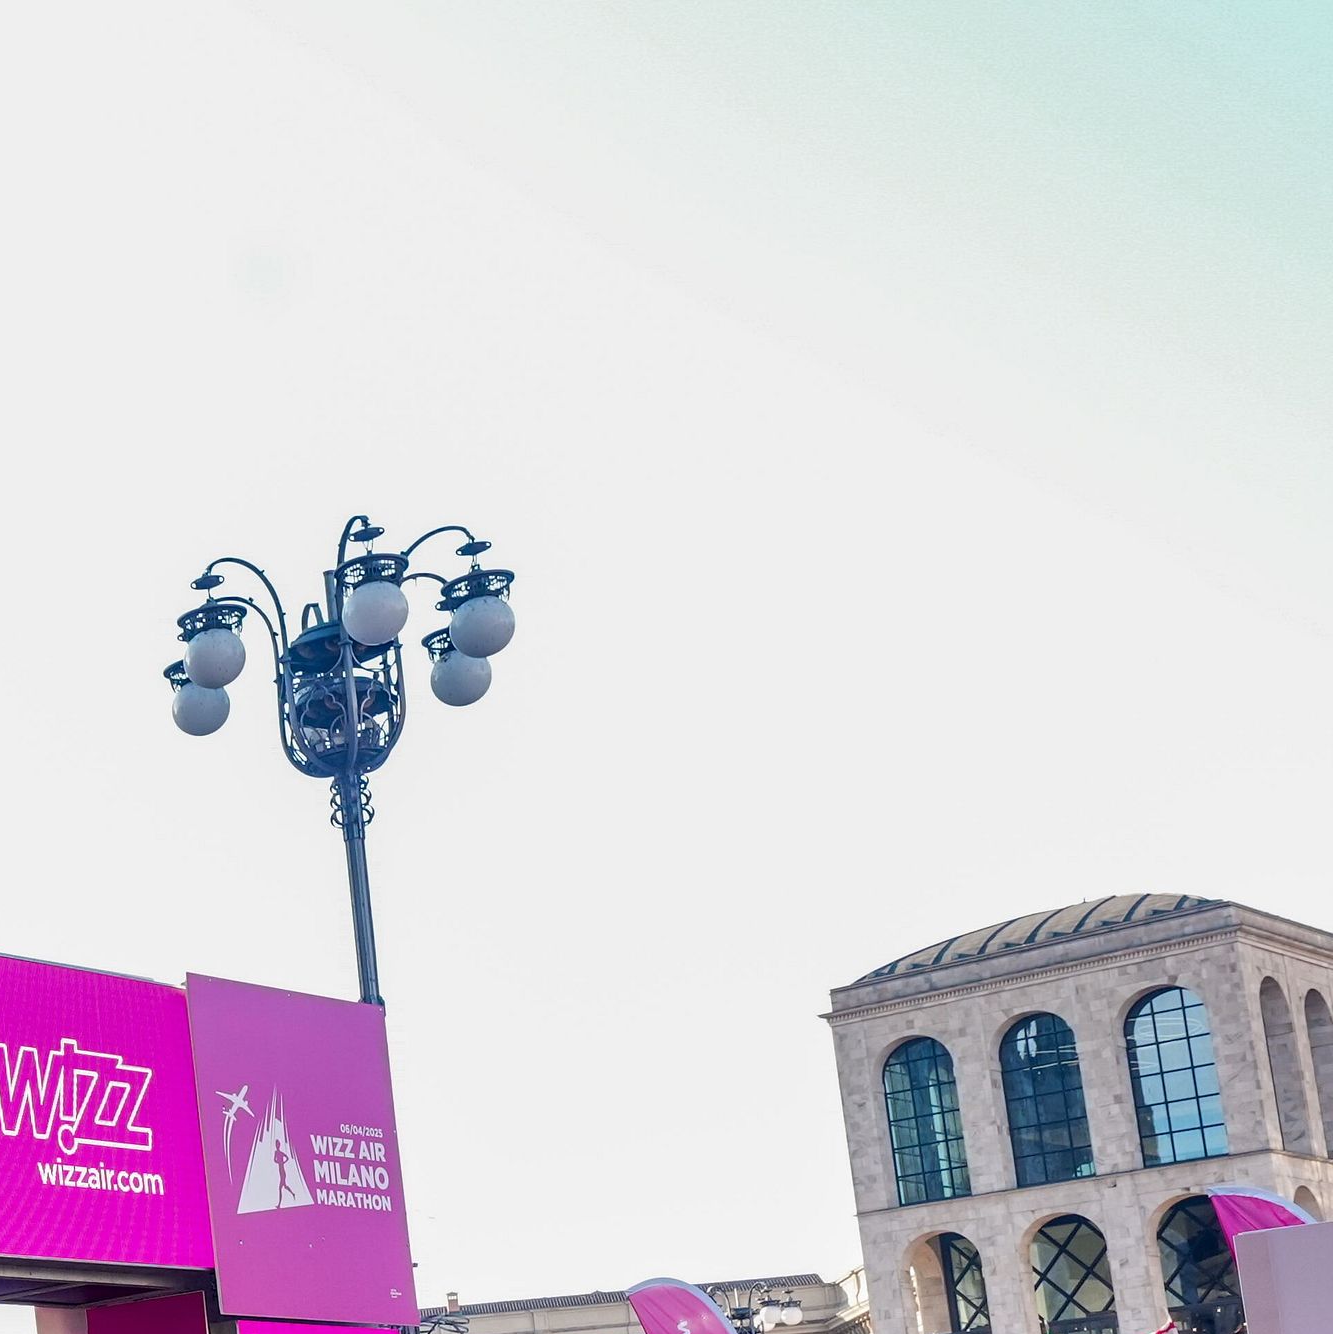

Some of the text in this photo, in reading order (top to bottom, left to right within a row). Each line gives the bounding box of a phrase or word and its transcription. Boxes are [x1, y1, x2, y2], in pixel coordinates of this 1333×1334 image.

[339, 1123, 384, 1139] 06/04/2025
[310, 1133, 387, 1163] WIZZ AIR
[37, 1156, 164, 1196] wizzair.com
[312, 1159, 391, 1191] MILANO
[316, 1188, 393, 1213] MARATHON
